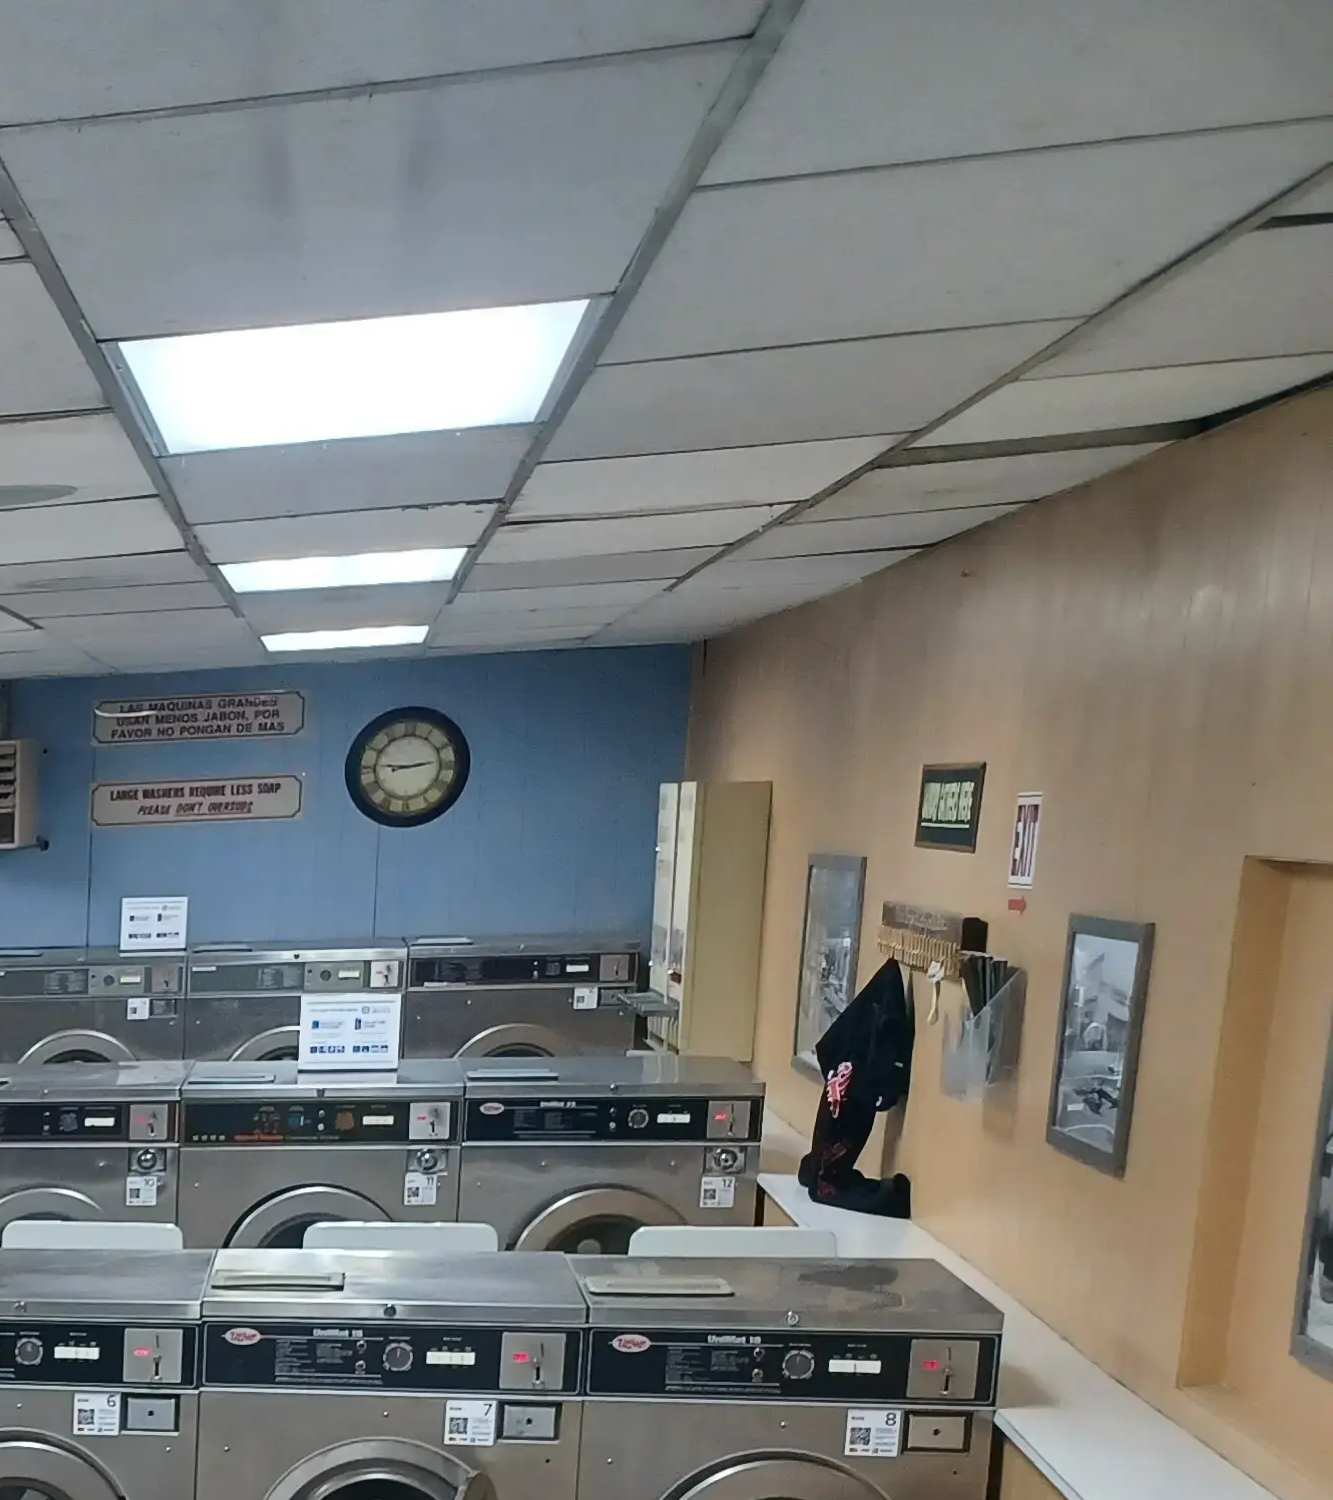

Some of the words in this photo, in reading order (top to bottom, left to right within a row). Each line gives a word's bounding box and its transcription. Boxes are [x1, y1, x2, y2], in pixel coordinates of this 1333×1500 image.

[148, 700, 213, 712] MAQUINAS
[217, 696, 278, 709] GRANDES
[116, 714, 150, 728] USAN
[155, 712, 198, 725] MENOS
[203, 711, 249, 724] JABON,
[254, 708, 280, 720] POR
[110, 728, 152, 740] FAVOR
[157, 726, 175, 737] NO
[179, 724, 232, 736] PONGAN
[236, 722, 253, 733] DE
[257, 721, 285, 732] MAS
[110, 789, 139, 801] LARGE
[142, 787, 185, 800] WASHERS
[188, 785, 226, 798] REQUIRE
[230, 783, 253, 796] LESS
[257, 782, 282, 795] SOAP
[137, 804, 171, 815] PLEASE
[174, 802, 203, 814] DON'T
[1010, 804, 1041, 877] EXIT
[426, 1176, 434, 1186] 11
[721, 1178, 733, 1188] 12
[106, 1394, 117, 1408] 6
[483, 1403, 494, 1416] 7
[884, 1411, 897, 1427] 8
